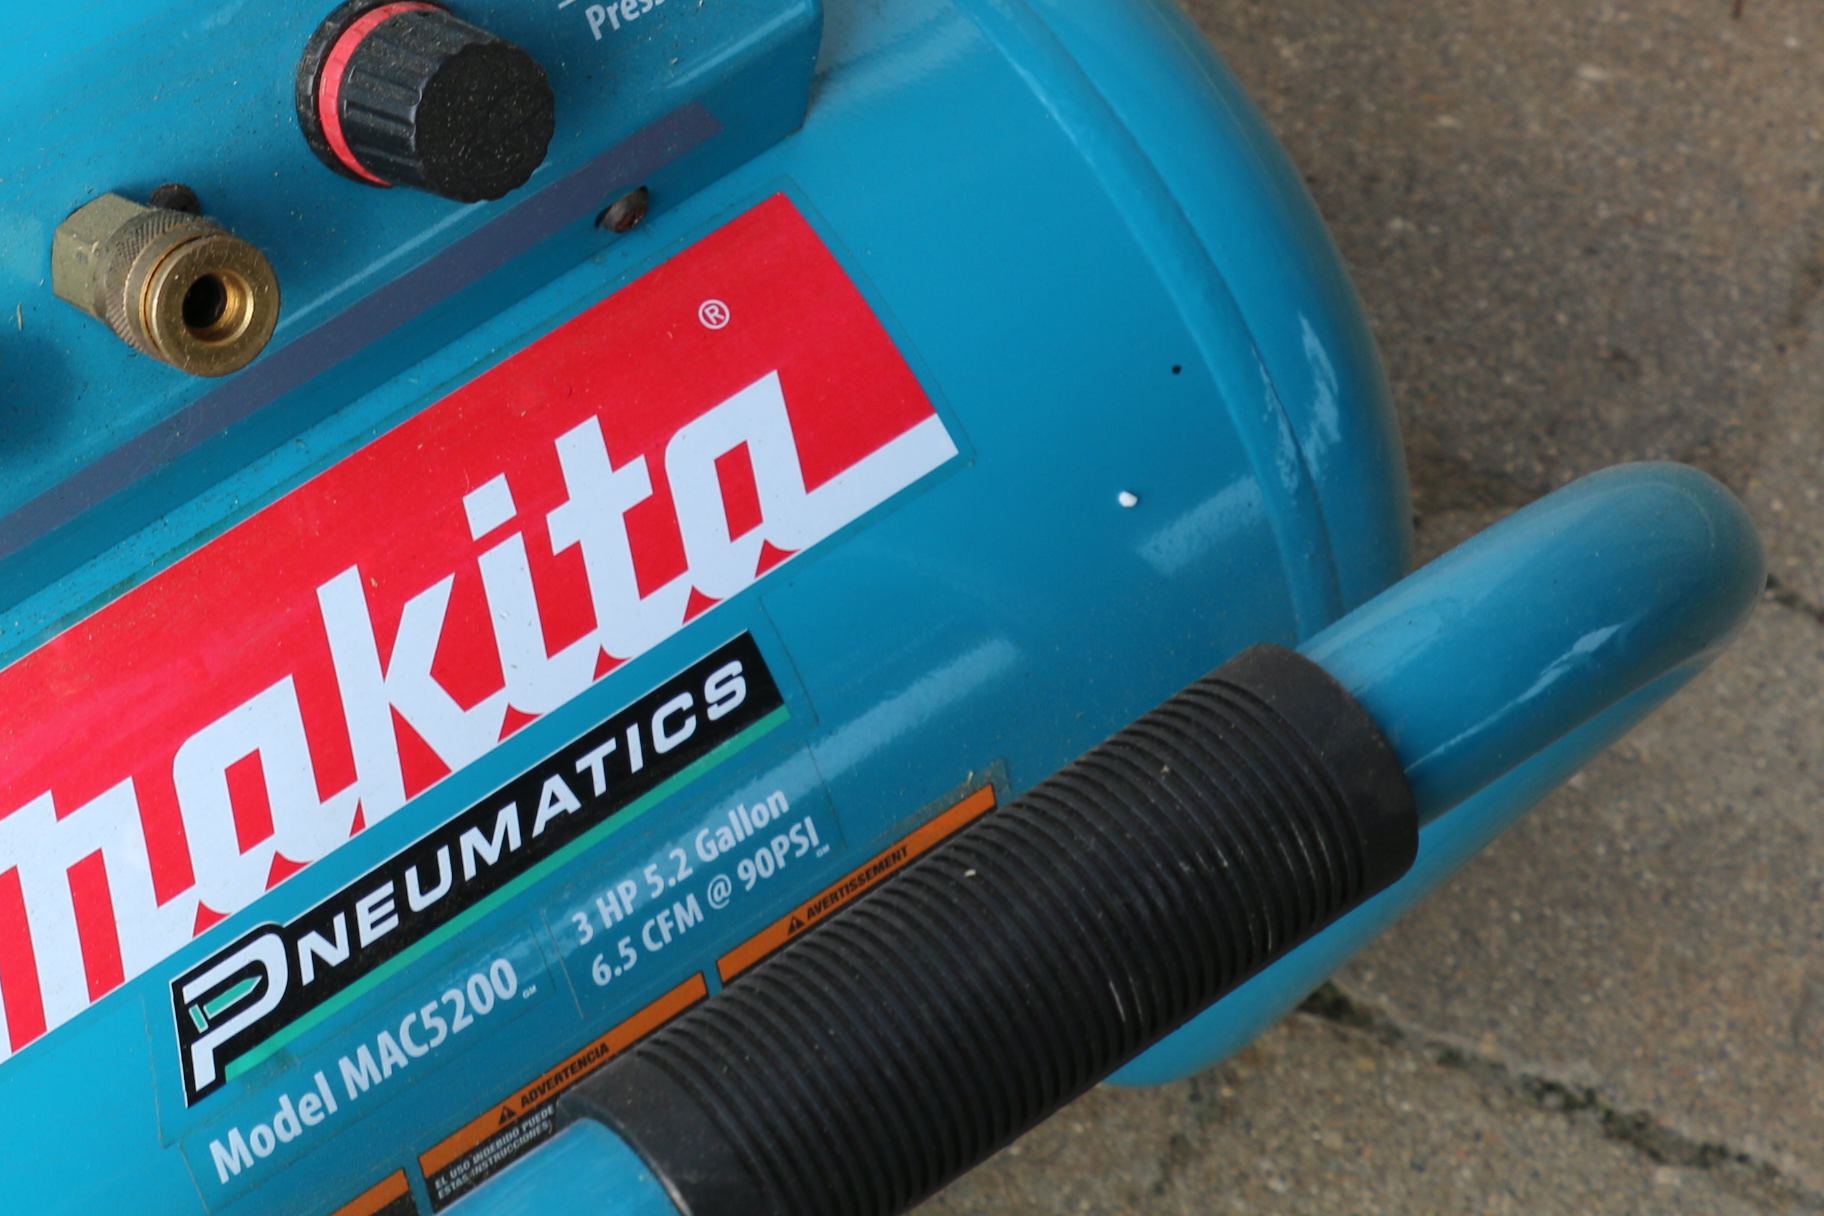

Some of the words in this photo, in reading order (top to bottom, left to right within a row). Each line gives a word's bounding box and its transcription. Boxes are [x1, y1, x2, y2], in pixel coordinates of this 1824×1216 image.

[182, 660, 747, 1091] PNEUMATICS
[572, 911, 594, 945] 3
[596, 880, 637, 929] HP
[645, 848, 693, 897] 5.2
[695, 790, 789, 862] Gallon
[592, 936, 637, 986] 6.5
[642, 893, 703, 952] CFM
[708, 874, 732, 909] @
[738, 816, 820, 891] 90PSI
[807, 845, 908, 921] AVERTISSEMENT
[209, 1071, 338, 1184] Model
[338, 958, 518, 1100] MAC5200
[521, 1043, 610, 1109] ADVERTENCIA
[435, 1176, 448, 1189] EL
[450, 1161, 470, 1178] USO
[472, 1127, 520, 1163] INDEBIDO
[522, 1104, 554, 1132] PUEDE
[438, 1174, 469, 1200] ESTAS
